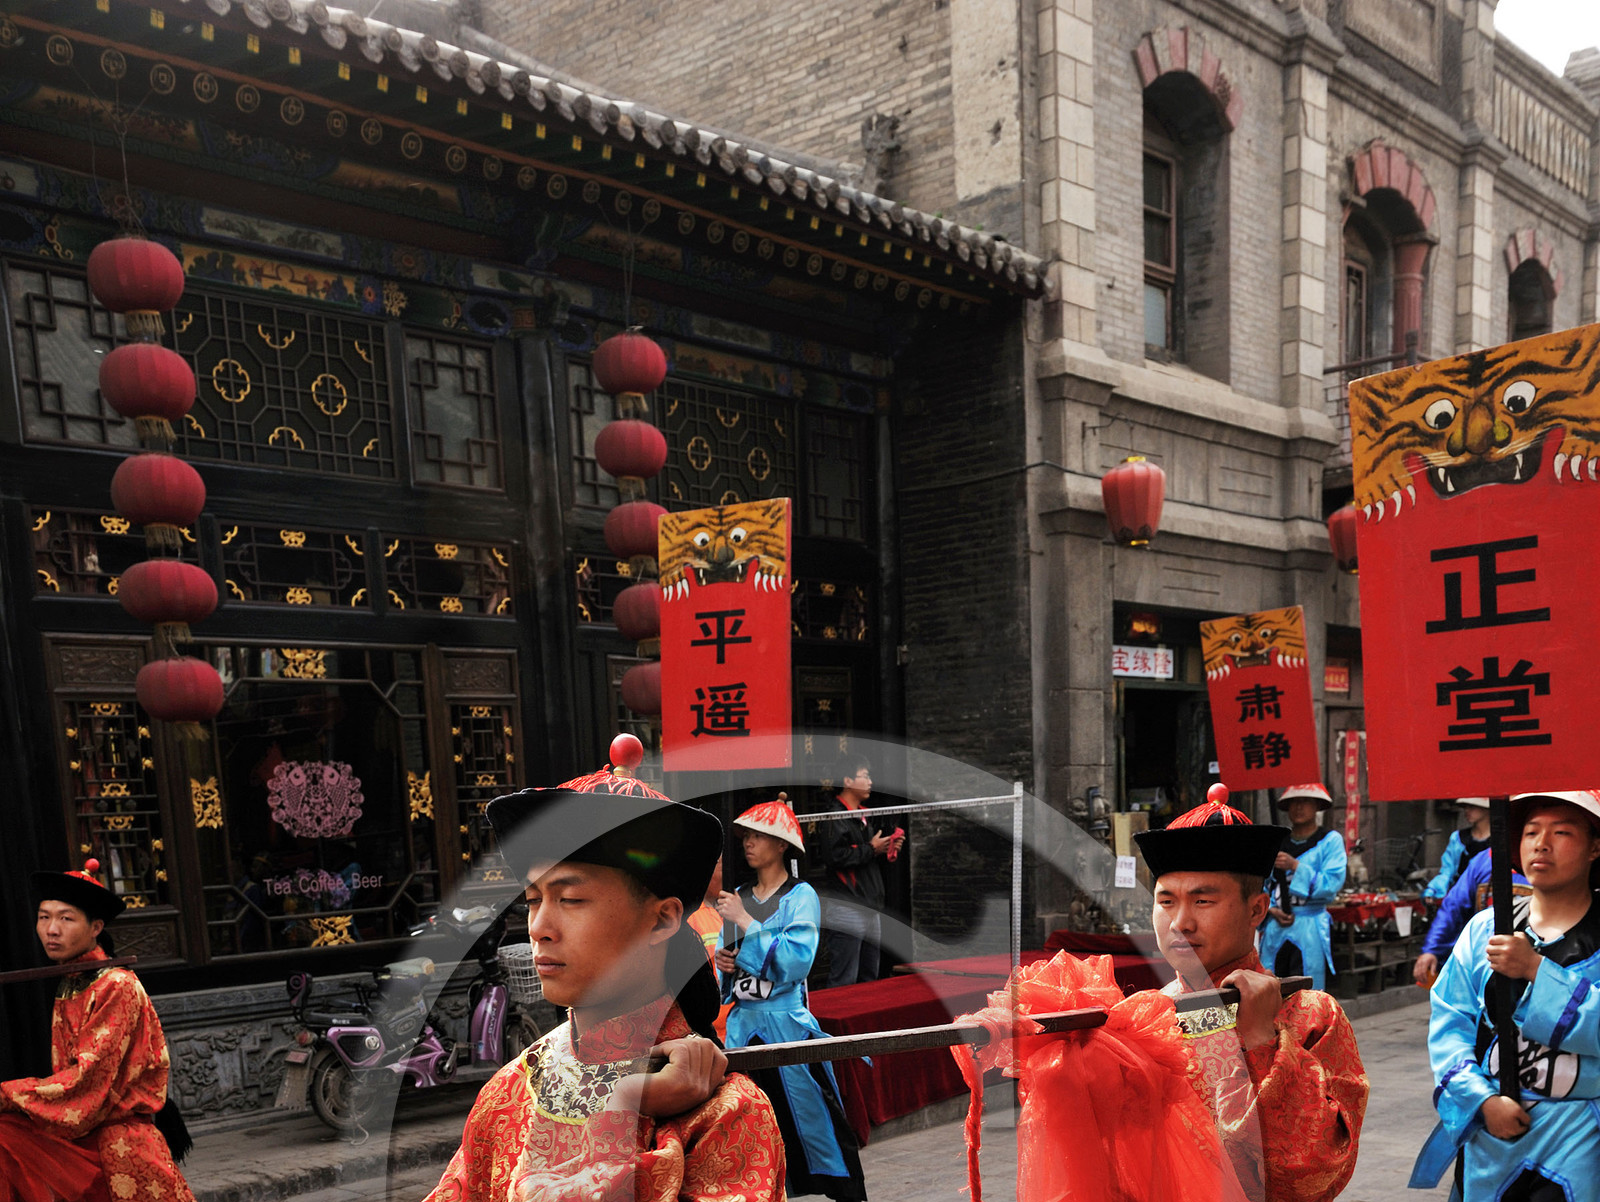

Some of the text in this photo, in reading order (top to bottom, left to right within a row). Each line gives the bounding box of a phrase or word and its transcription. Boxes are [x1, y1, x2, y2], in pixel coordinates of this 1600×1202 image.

[690, 609, 752, 737] 平遥
[1426, 535, 1552, 752] 正堂
[1235, 684, 1292, 770] 肃静
[263, 872, 383, 896] Tea Coffee Beer
